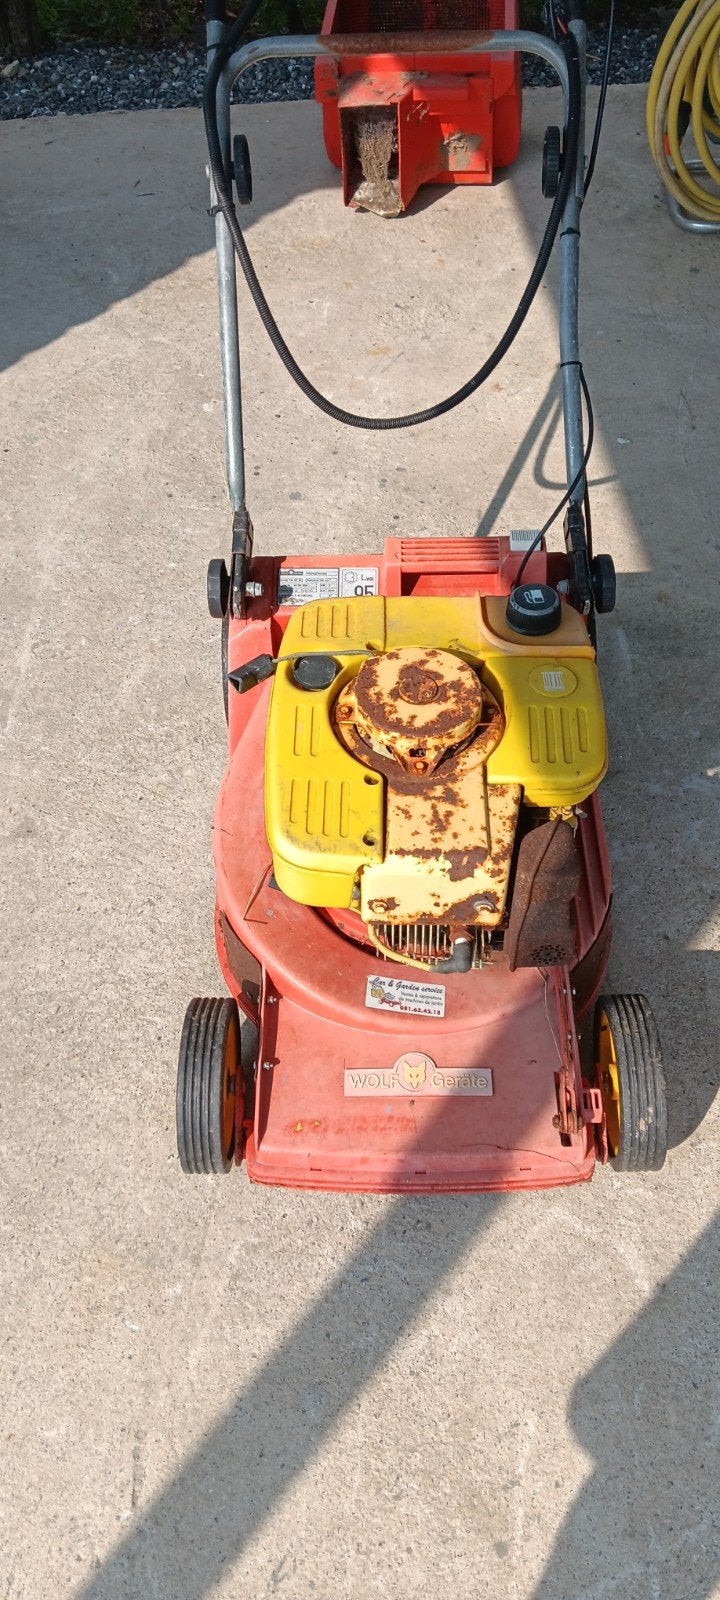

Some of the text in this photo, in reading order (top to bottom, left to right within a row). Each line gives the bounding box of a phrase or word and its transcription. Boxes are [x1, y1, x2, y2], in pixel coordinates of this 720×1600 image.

[369, 977, 386, 986] Car
[395, 981, 420, 991] Garden
[350, 1072, 489, 1089] WOLF Geräte
